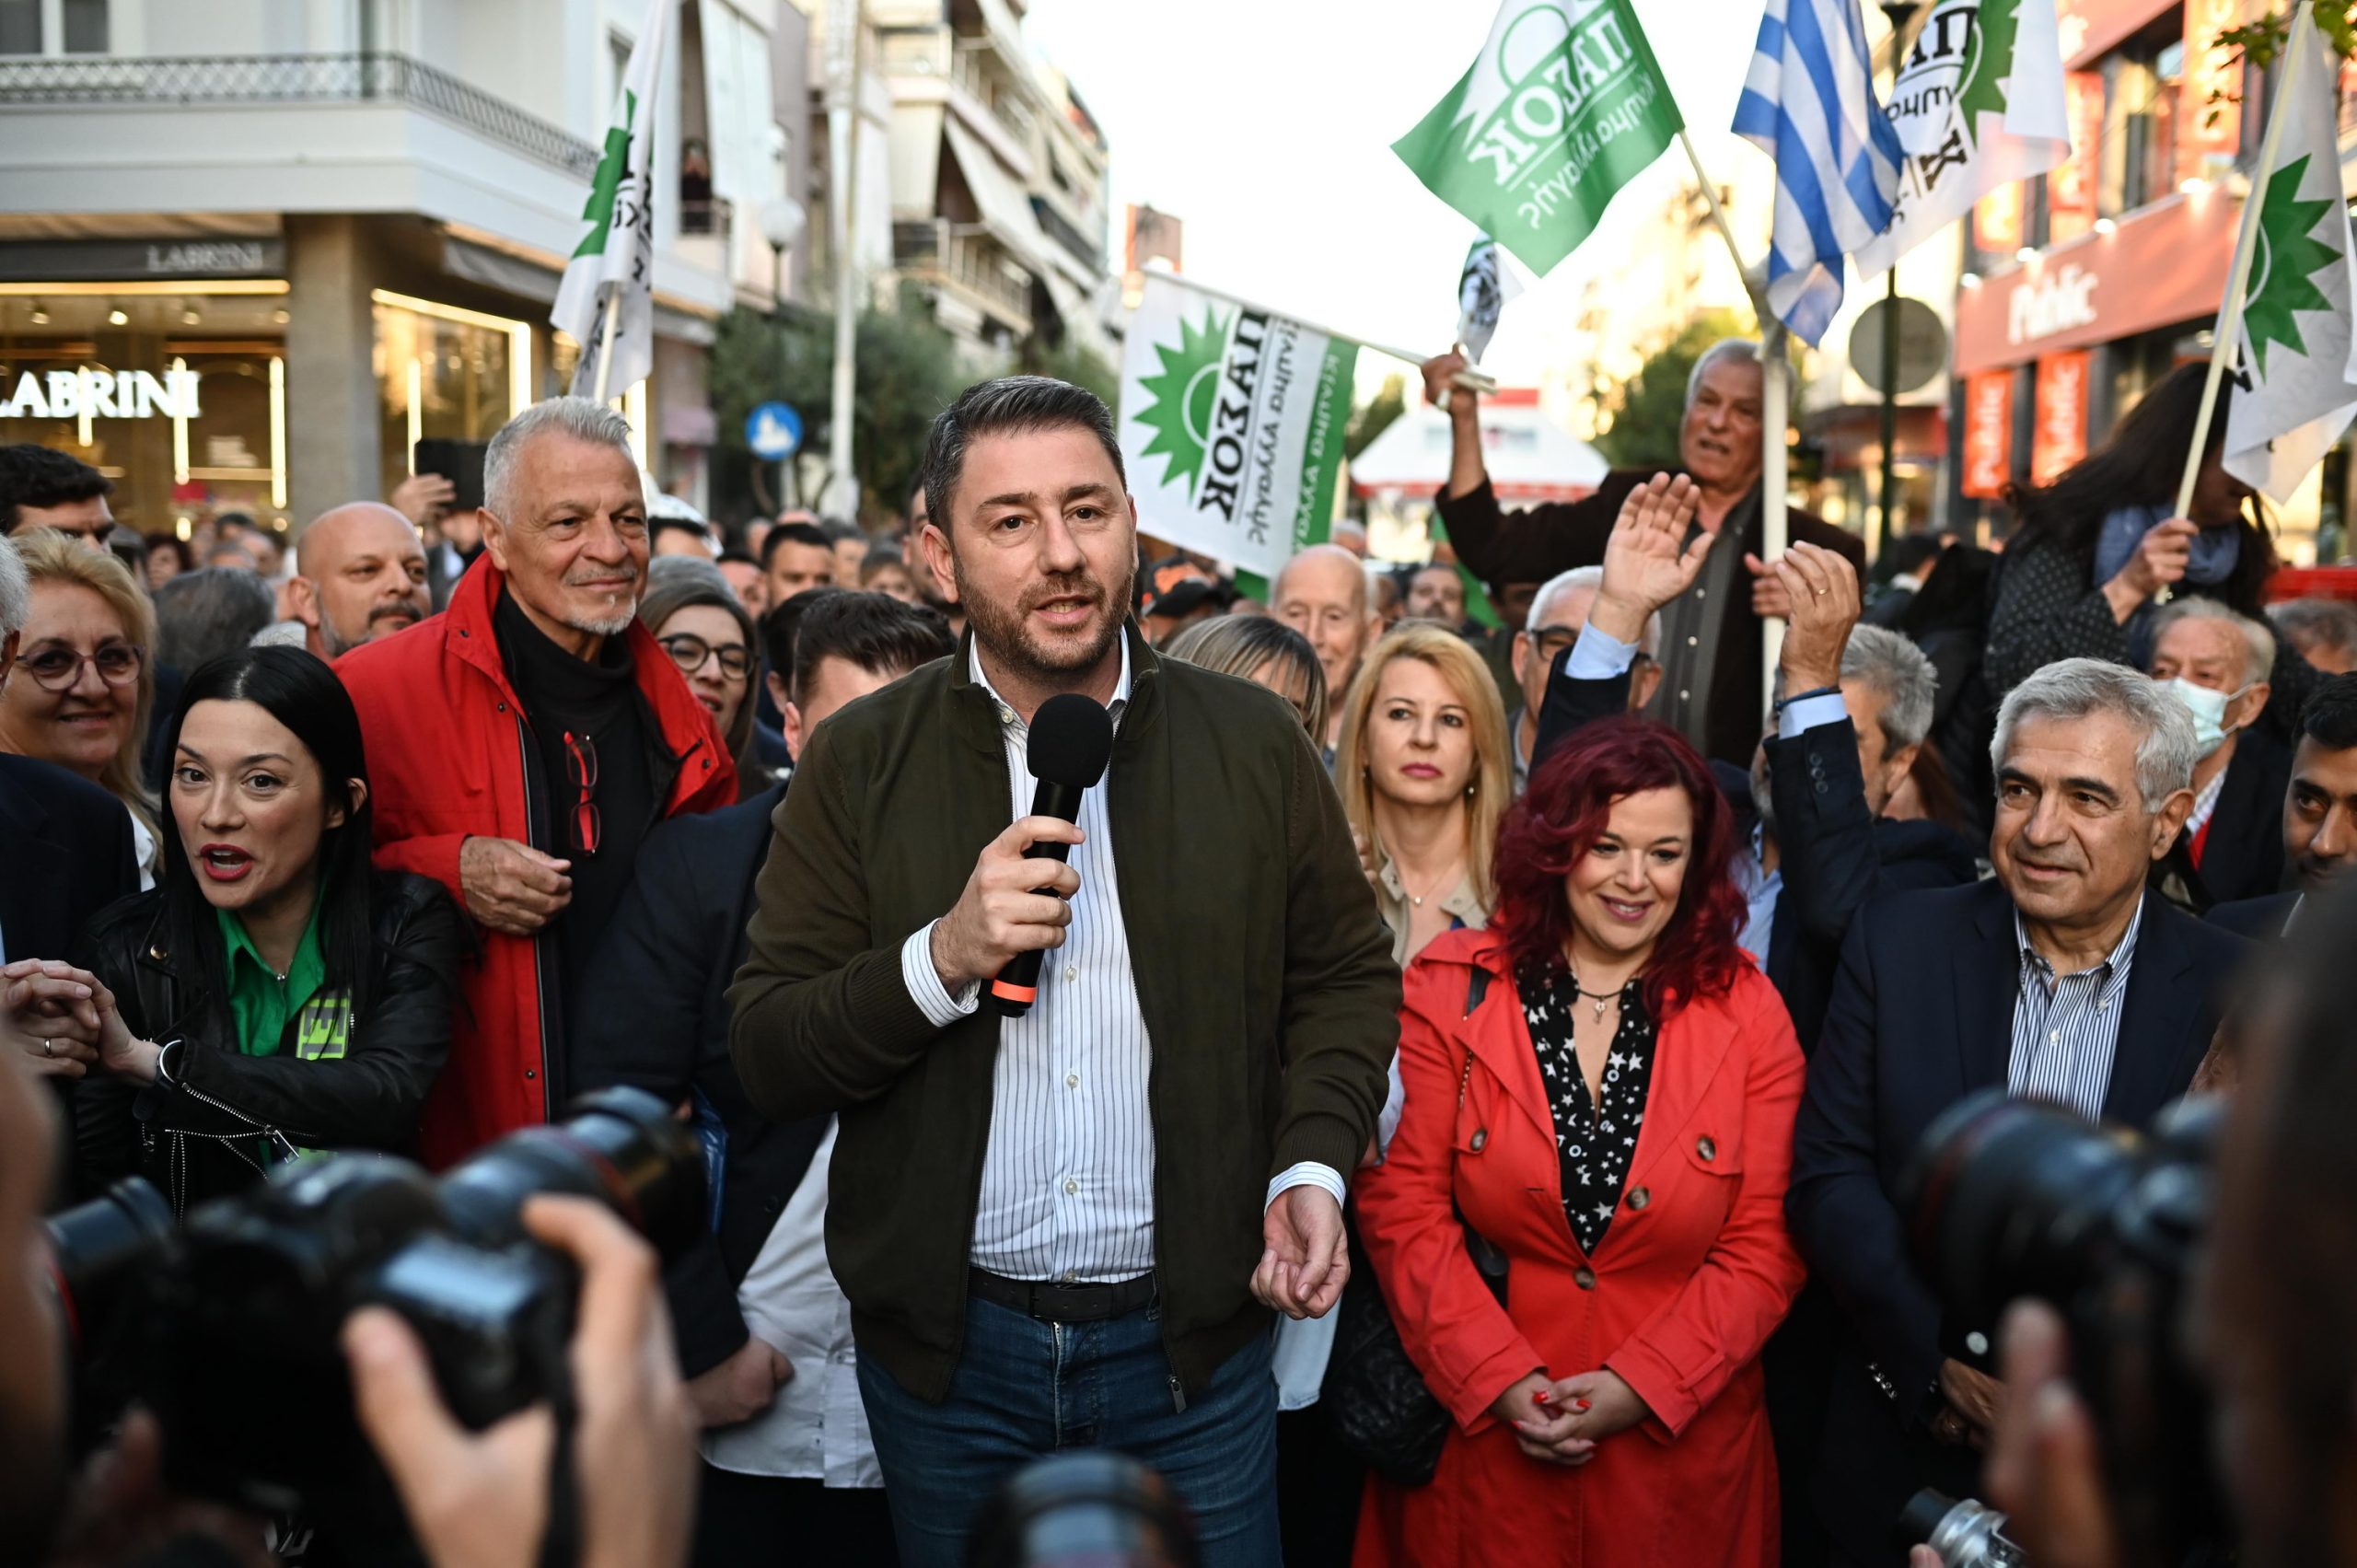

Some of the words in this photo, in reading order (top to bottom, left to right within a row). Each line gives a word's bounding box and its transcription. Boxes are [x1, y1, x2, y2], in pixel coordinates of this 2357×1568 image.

[146, 243, 262, 273] LABRINI
[2008, 263, 2098, 346] Public
[0, 370, 202, 418] ABRINI
